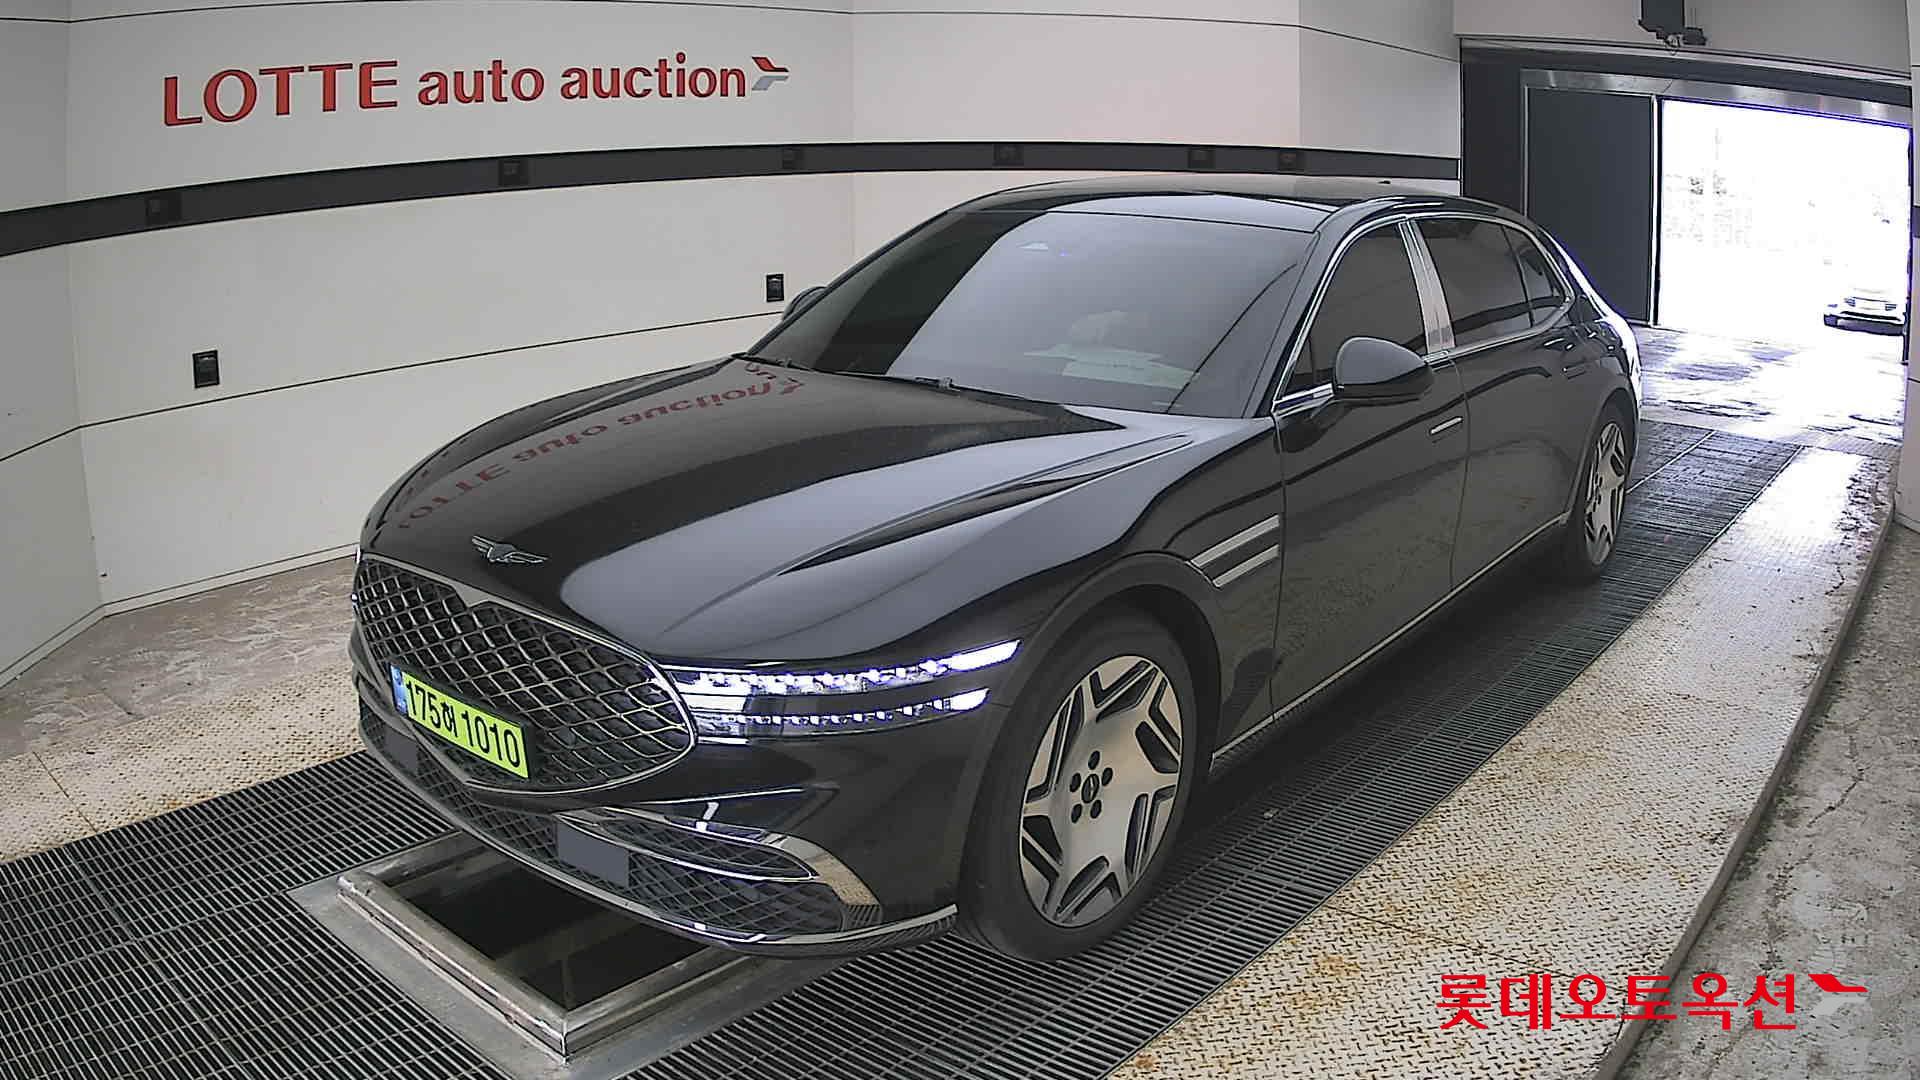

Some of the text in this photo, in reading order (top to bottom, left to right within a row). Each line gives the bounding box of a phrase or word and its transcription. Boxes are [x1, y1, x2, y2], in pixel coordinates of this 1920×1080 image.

[164, 52, 747, 127] LOTTE auto auction
[406, 680, 520, 768] 175허 1010
